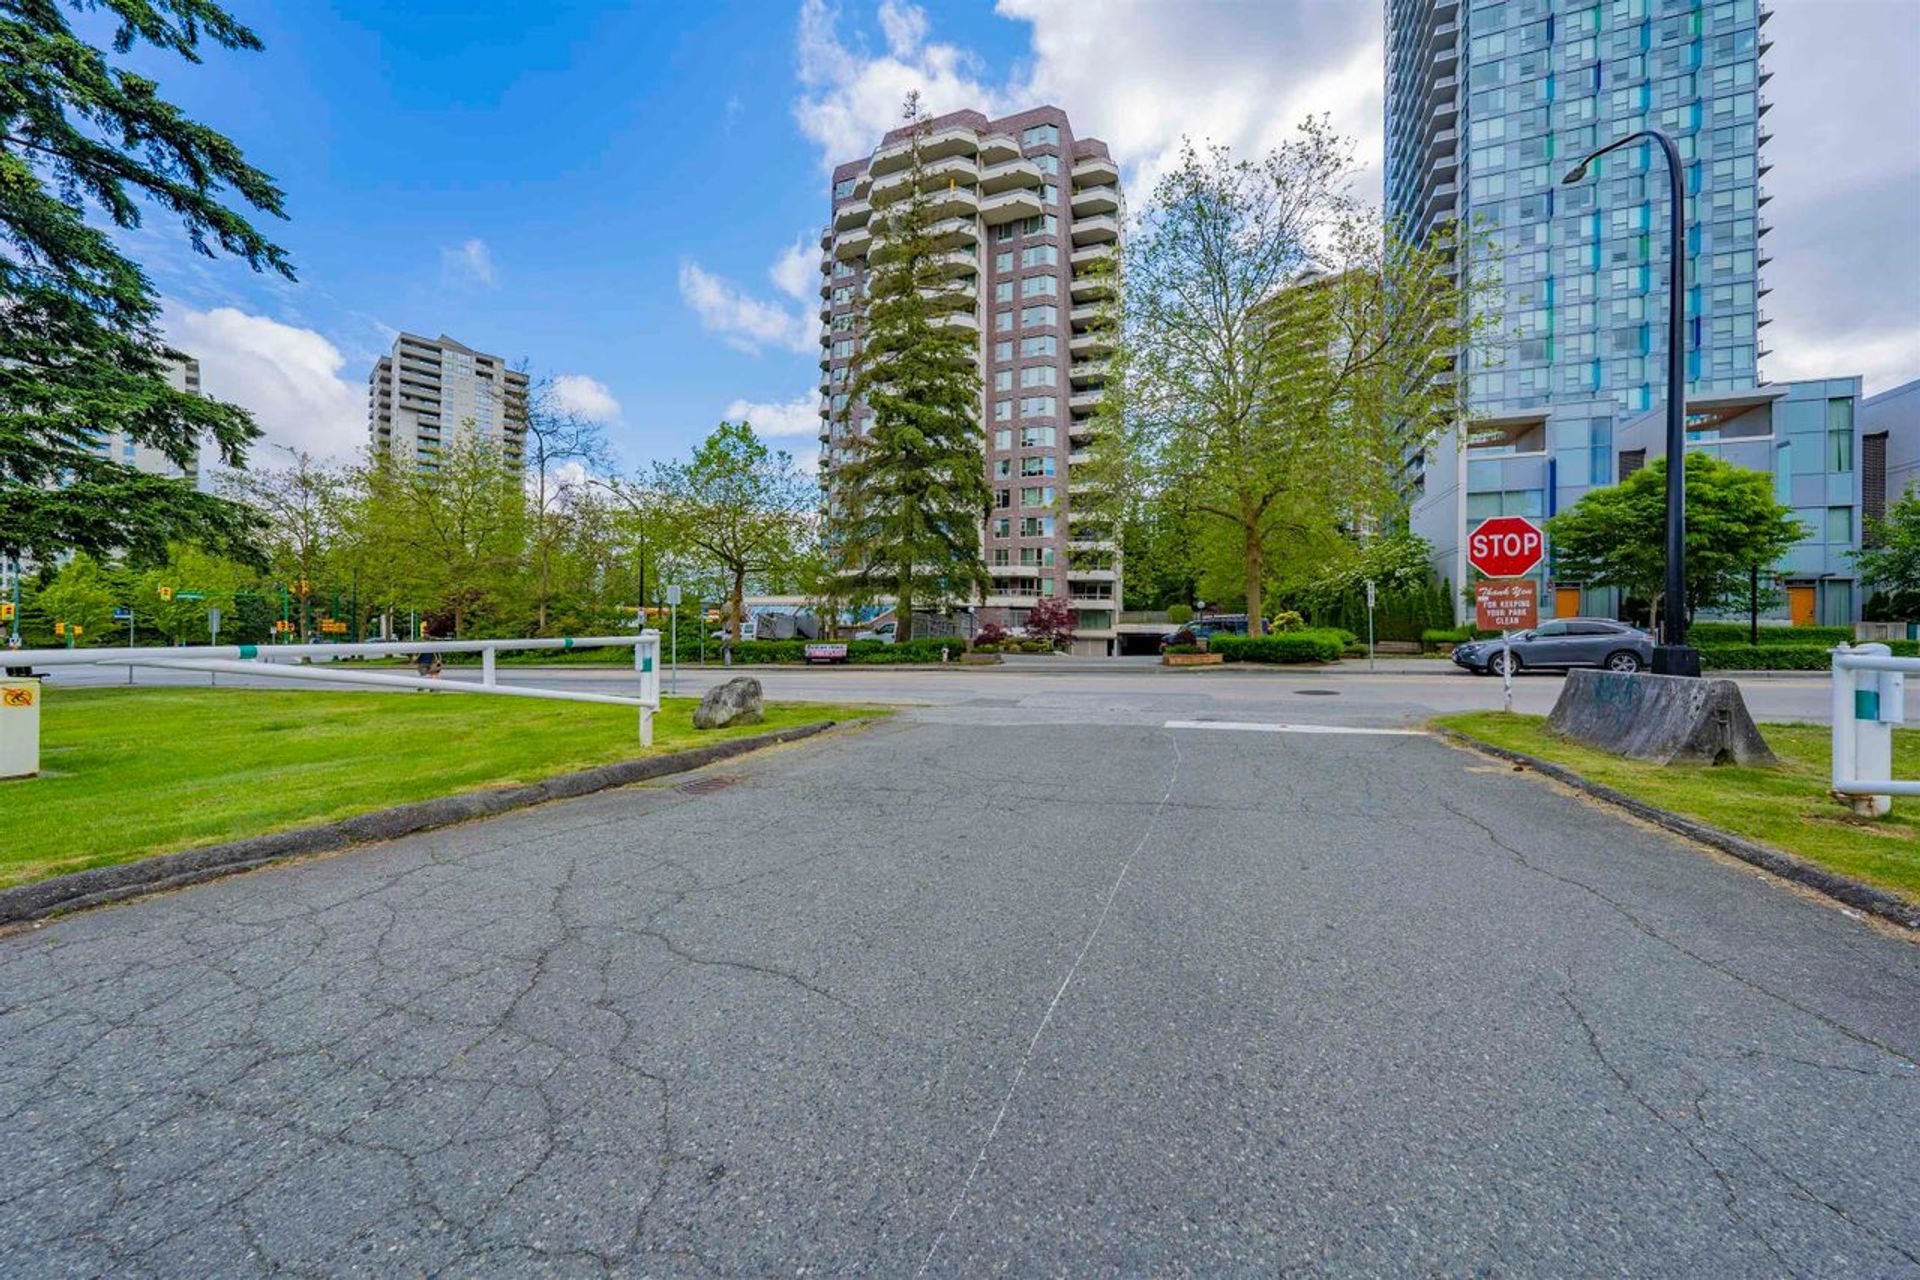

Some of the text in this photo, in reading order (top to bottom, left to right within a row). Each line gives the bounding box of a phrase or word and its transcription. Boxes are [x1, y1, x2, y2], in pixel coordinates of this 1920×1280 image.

[1473, 533, 1538, 558] STOP
[1479, 586, 1532, 598] Thank You
[1483, 600, 1530, 609] FOR KEEPING
[1495, 616, 1519, 625] CLEAN
